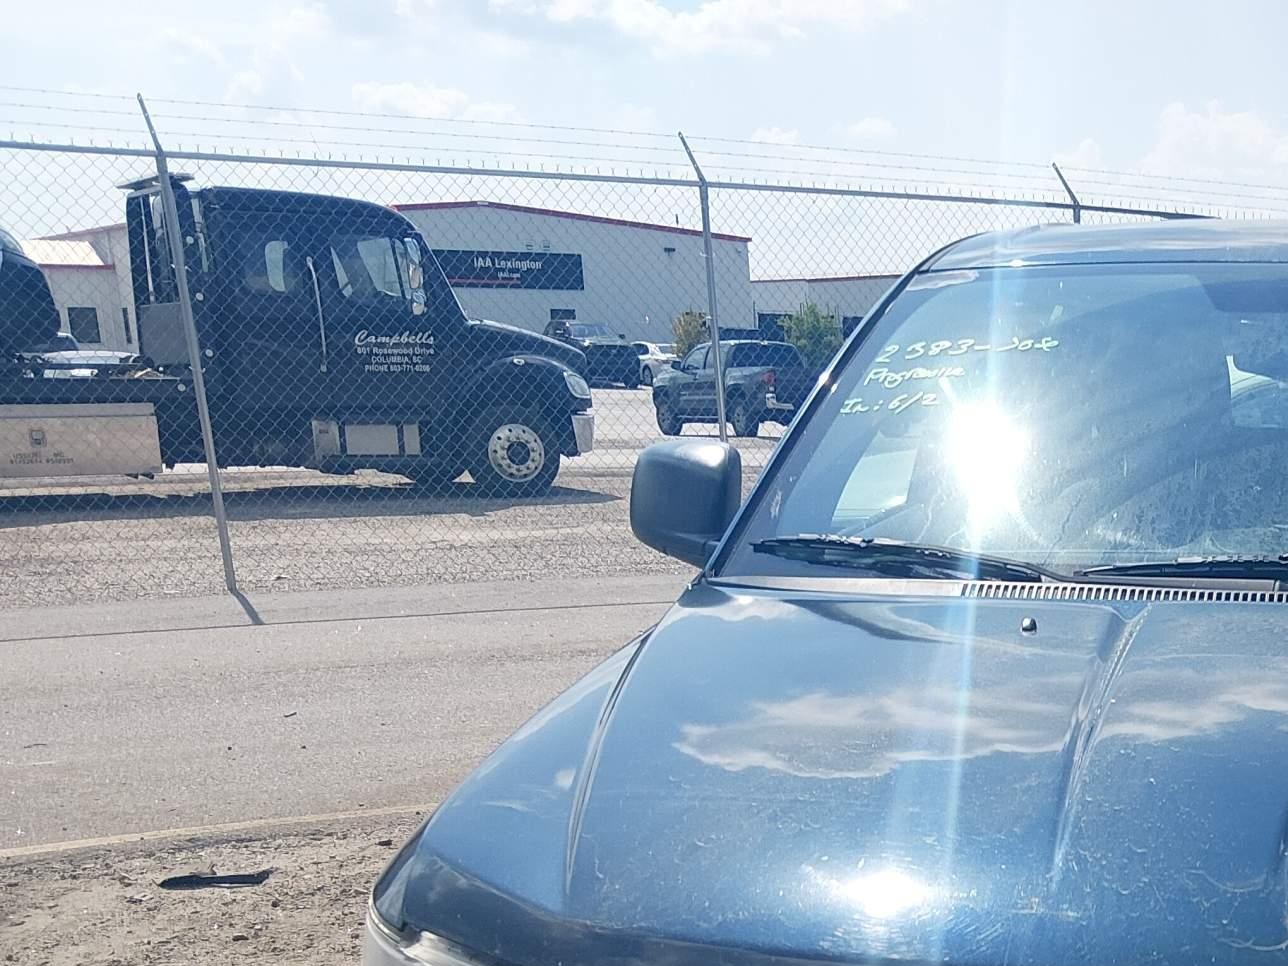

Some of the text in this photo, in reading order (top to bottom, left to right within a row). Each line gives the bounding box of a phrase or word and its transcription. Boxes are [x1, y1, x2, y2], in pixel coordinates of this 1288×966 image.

[474, 257, 542, 270] IAA Lexington
[355, 330, 434, 346] Campbell's
